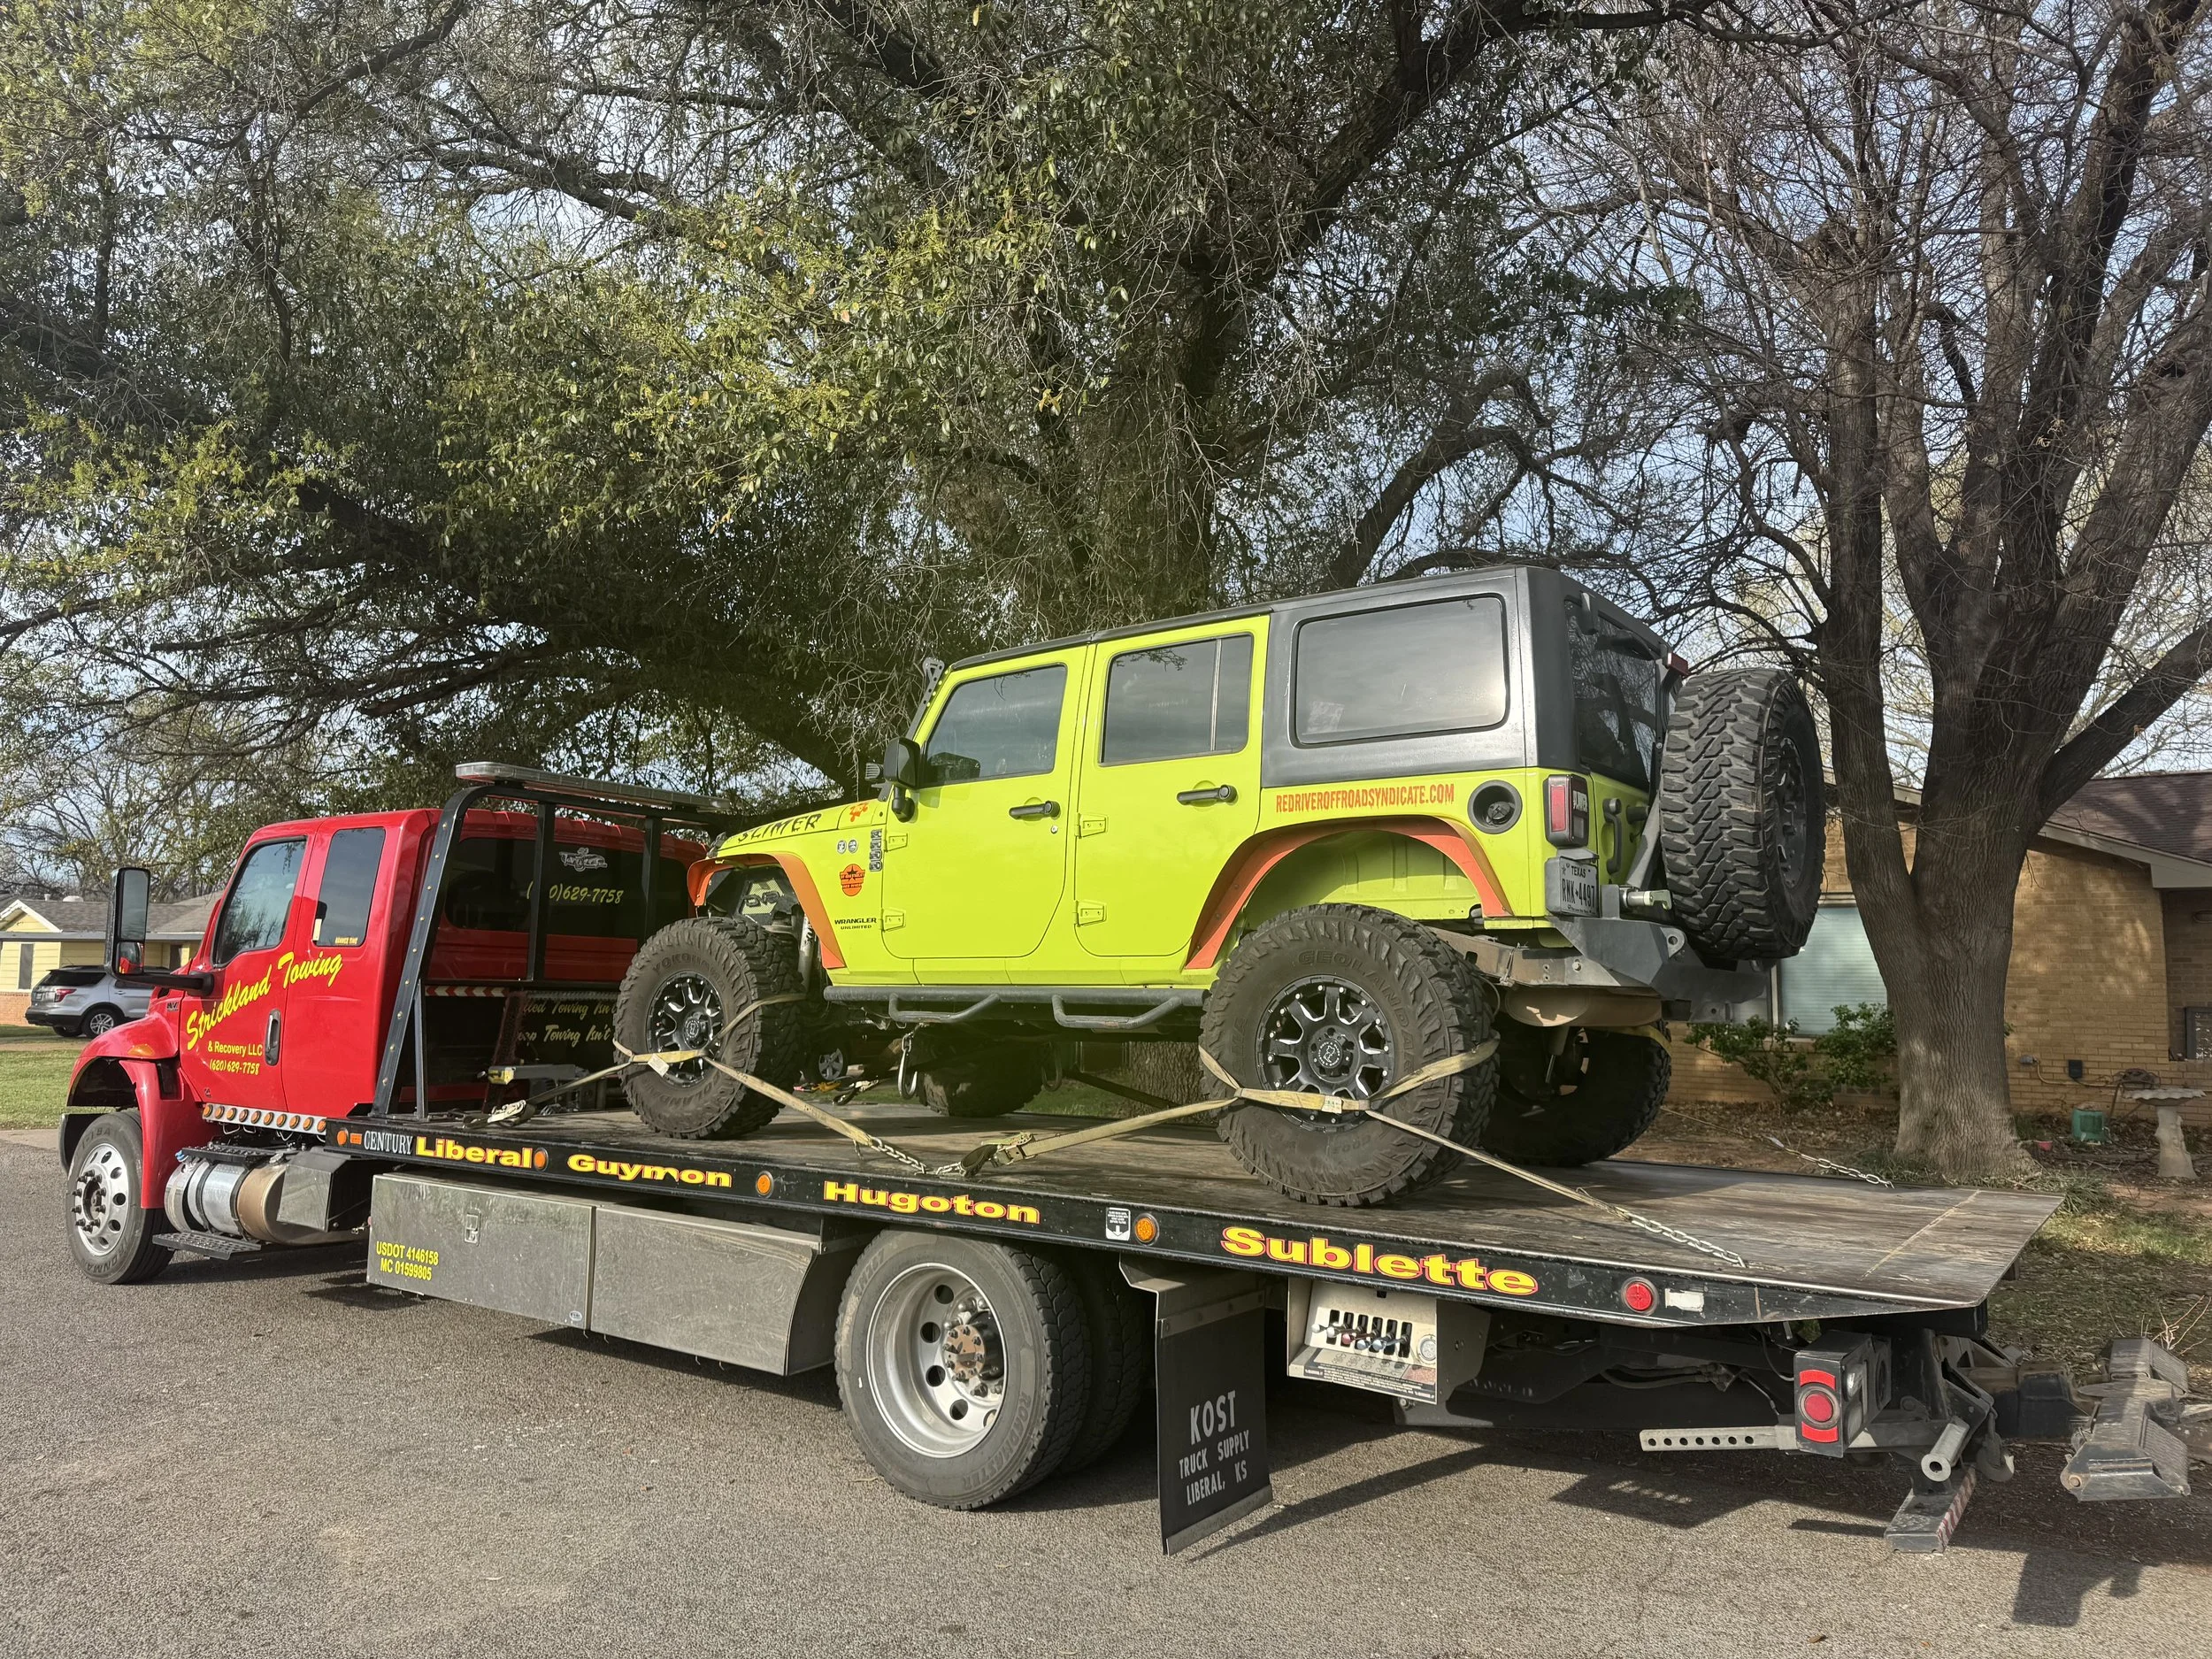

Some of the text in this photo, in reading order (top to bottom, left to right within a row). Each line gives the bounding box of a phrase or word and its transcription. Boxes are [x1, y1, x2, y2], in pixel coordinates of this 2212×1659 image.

[1275, 784, 1455, 813] REDRIVEROFFROADSYNDICATE.COM
[1571, 865, 1586, 879] TEXAS
[526, 880, 625, 904] (0)629-7758
[834, 917, 877, 926] WRANGLER
[186, 951, 343, 1050] Strickland Towing
[543, 1025, 581, 1048] Towing
[586, 1024, 611, 1041] Isn't
[207, 1041, 263, 1057] & Recovery LLC
[363, 1130, 414, 1155] CENTURY
[415, 1136, 1539, 1296] Liberal Guymon Hugoton Sublette
[376, 1240, 439, 1266] USDOT 4146158
[380, 1257, 432, 1281] MC 01599805
[1190, 1390, 1236, 1446] KOST
[1179, 1430, 1249, 1479] TRUCK SUPPLY
[1187, 1460, 1248, 1506] LIBERAL, KS
